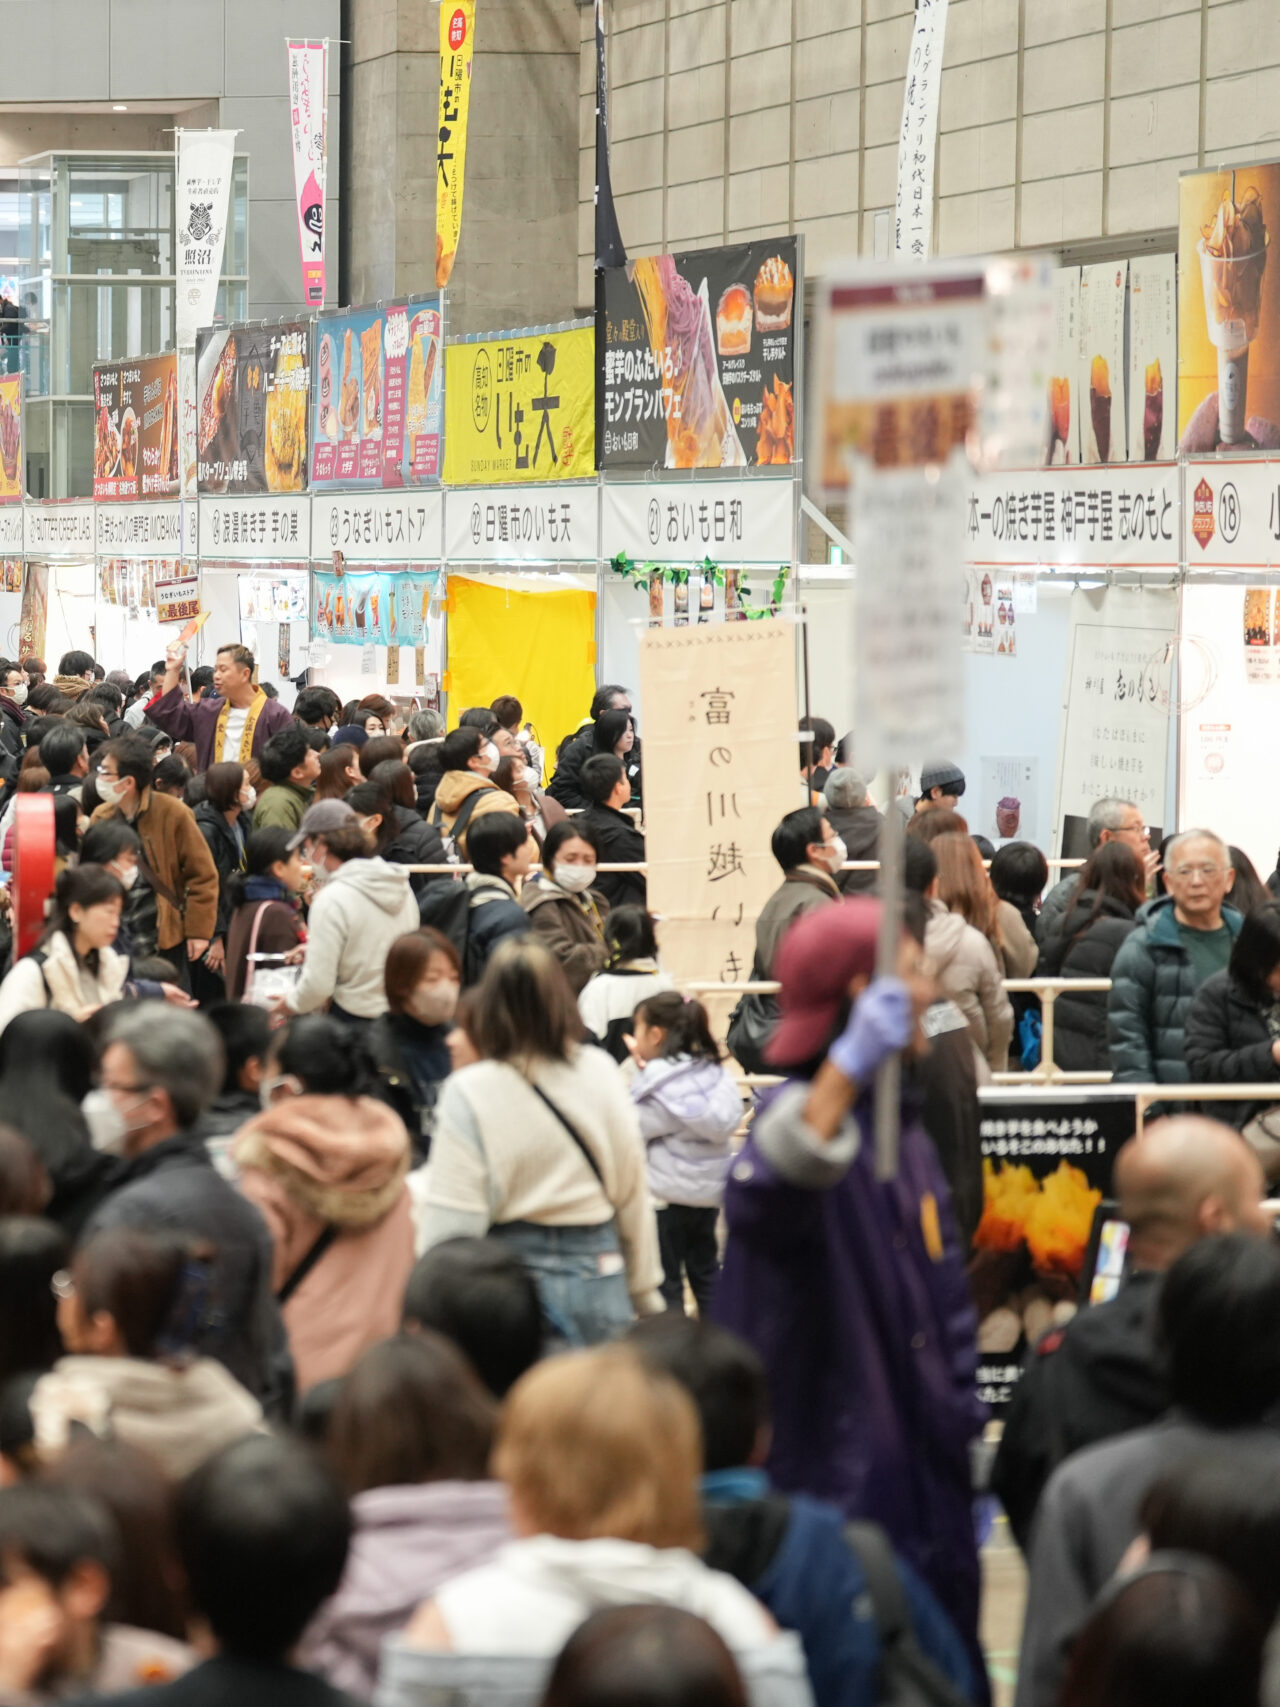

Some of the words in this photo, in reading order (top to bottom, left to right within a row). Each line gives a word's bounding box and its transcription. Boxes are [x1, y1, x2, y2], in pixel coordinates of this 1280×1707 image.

[605, 387, 682, 422] モンブランパフェ
[612, 431, 639, 451] おいも日和
[470, 459, 490, 473] SUNDAY
[492, 458, 512, 471] MARKET
[58, 517, 78, 541] CREPE
[223, 511, 267, 543] 浪漫焼き芋
[271, 509, 298, 543] 芋の巣
[342, 506, 426, 544] うなぎいもストア
[486, 503, 571, 543] 日曜市のいも天
[666, 499, 743, 543] おいも日和
[1061, 489, 1112, 541] 神戸芋屋
[1118, 487, 1173, 541] 志のもと
[160, 589, 195, 600] うなぎいもストア
[167, 600, 200, 618] 最後尾
